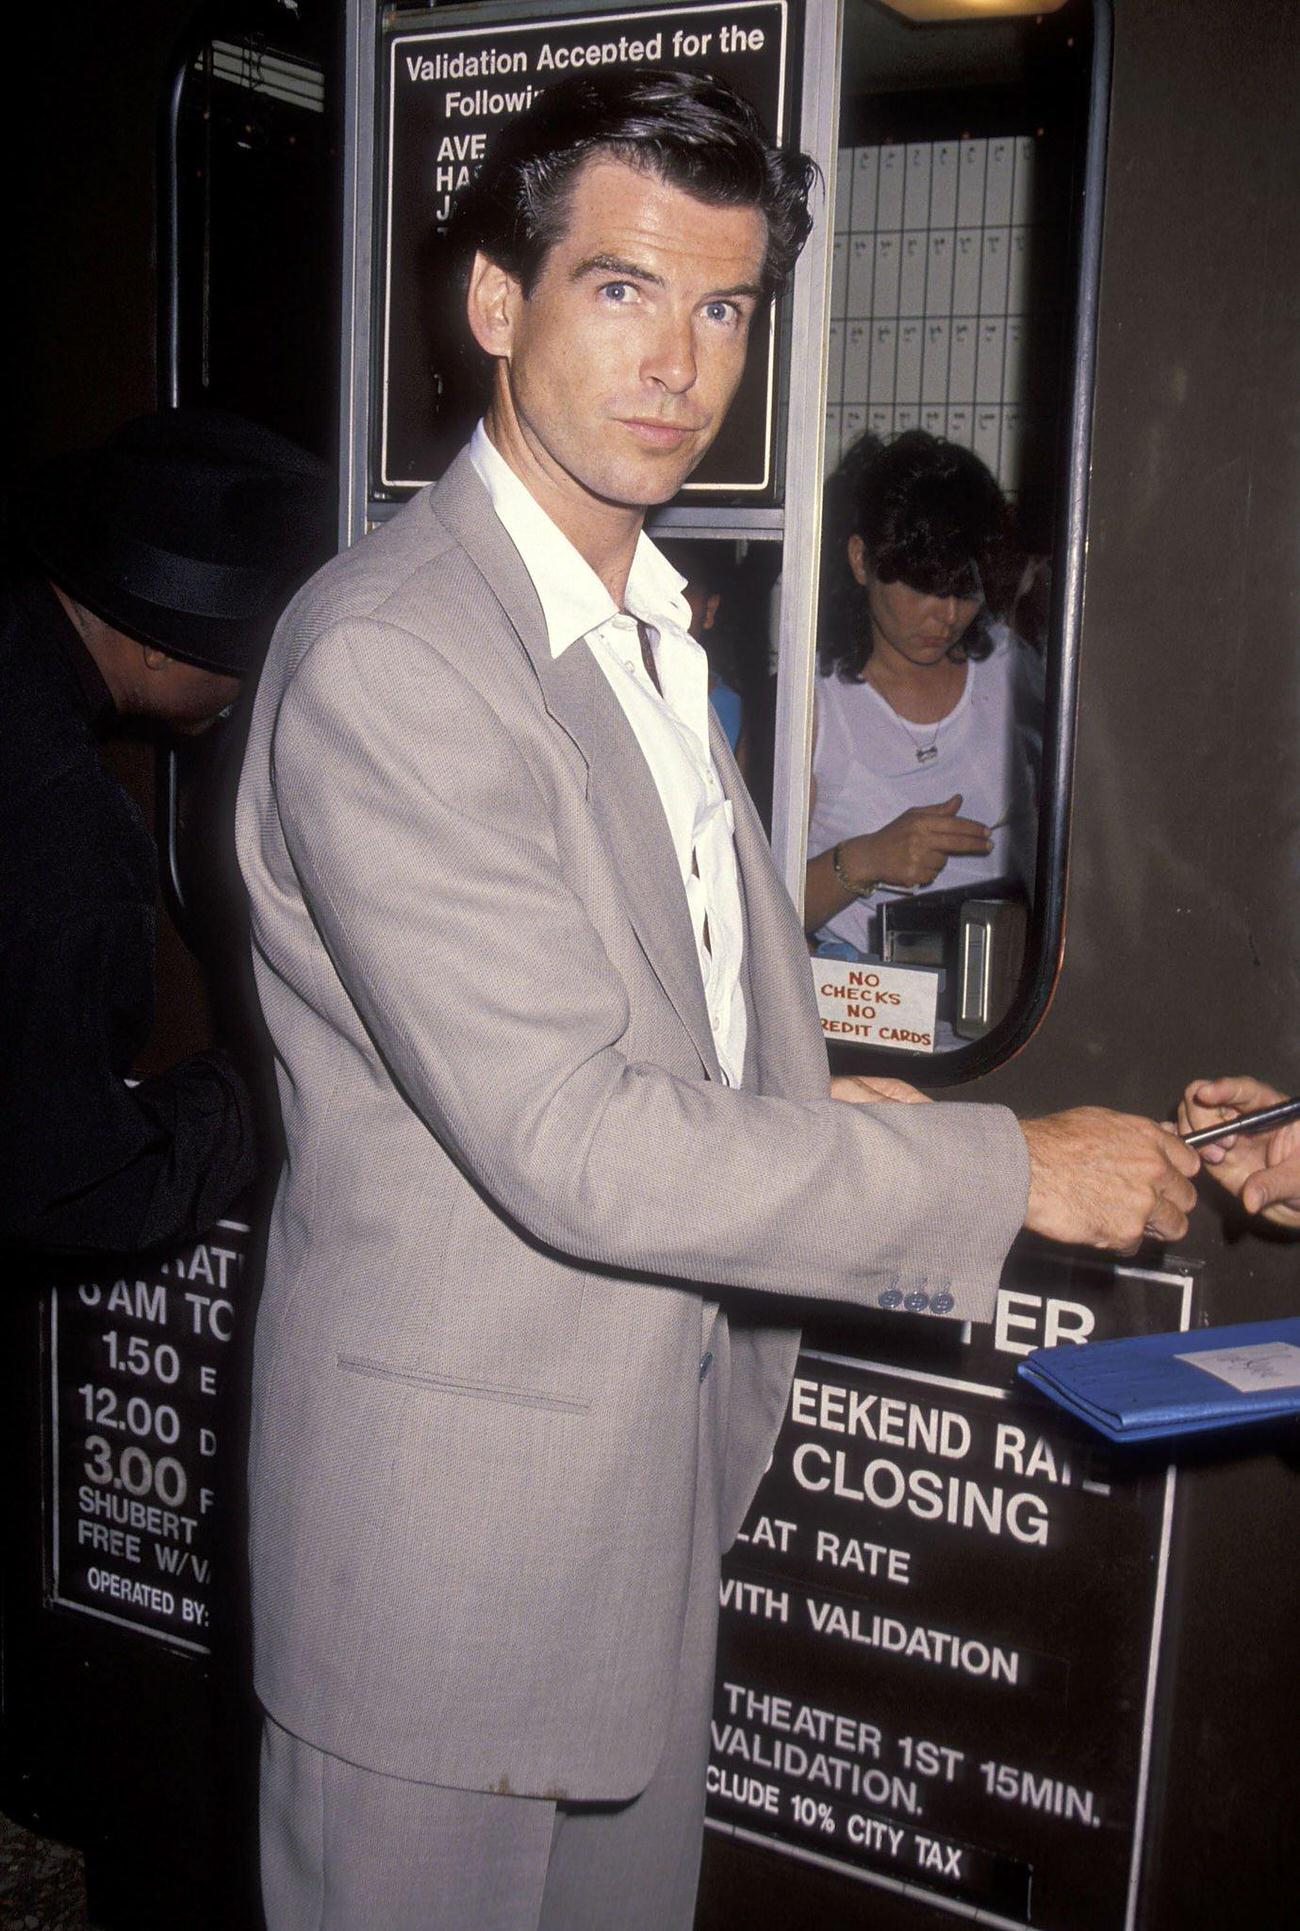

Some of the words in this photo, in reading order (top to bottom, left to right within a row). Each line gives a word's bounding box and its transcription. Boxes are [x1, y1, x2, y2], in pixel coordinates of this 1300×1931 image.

[406, 48, 528, 82] Validation
[536, 33, 662, 72] Accepted
[673, 30, 712, 58] for
[719, 25, 765, 53] the
[445, 85, 546, 118] Followi
[820, 984, 901, 1005] CHECKS
[849, 971, 880, 987] NO
[847, 1004, 876, 1019] NO
[878, 1027, 931, 1046] CARDS
[961, 1289, 1096, 1357] ER
[102, 1330, 181, 1384] 1.50
[78, 1383, 181, 1444] 12.00
[84, 1435, 188, 1507] 3.00
[792, 1442, 1049, 1547] CLOSING
[78, 1485, 198, 1545] SHUBERT
[78, 1518, 142, 1564] FREE
[154, 1543, 212, 1585] W/V
[815, 1530, 911, 1585] RATE
[87, 1566, 175, 1616] OPERATED
[181, 1596, 210, 1628] BY:
[806, 1598, 1020, 1686] VALIDATION
[710, 1719, 923, 1817] VALIDATION.
[723, 1681, 882, 1758] THEATER
[897, 1735, 964, 1783] 1ST
[979, 1761, 1101, 1828] 15MIN.
[790, 1793, 837, 1834] 10%
[847, 1813, 905, 1857] CITY
[914, 1834, 963, 1880] TAX
